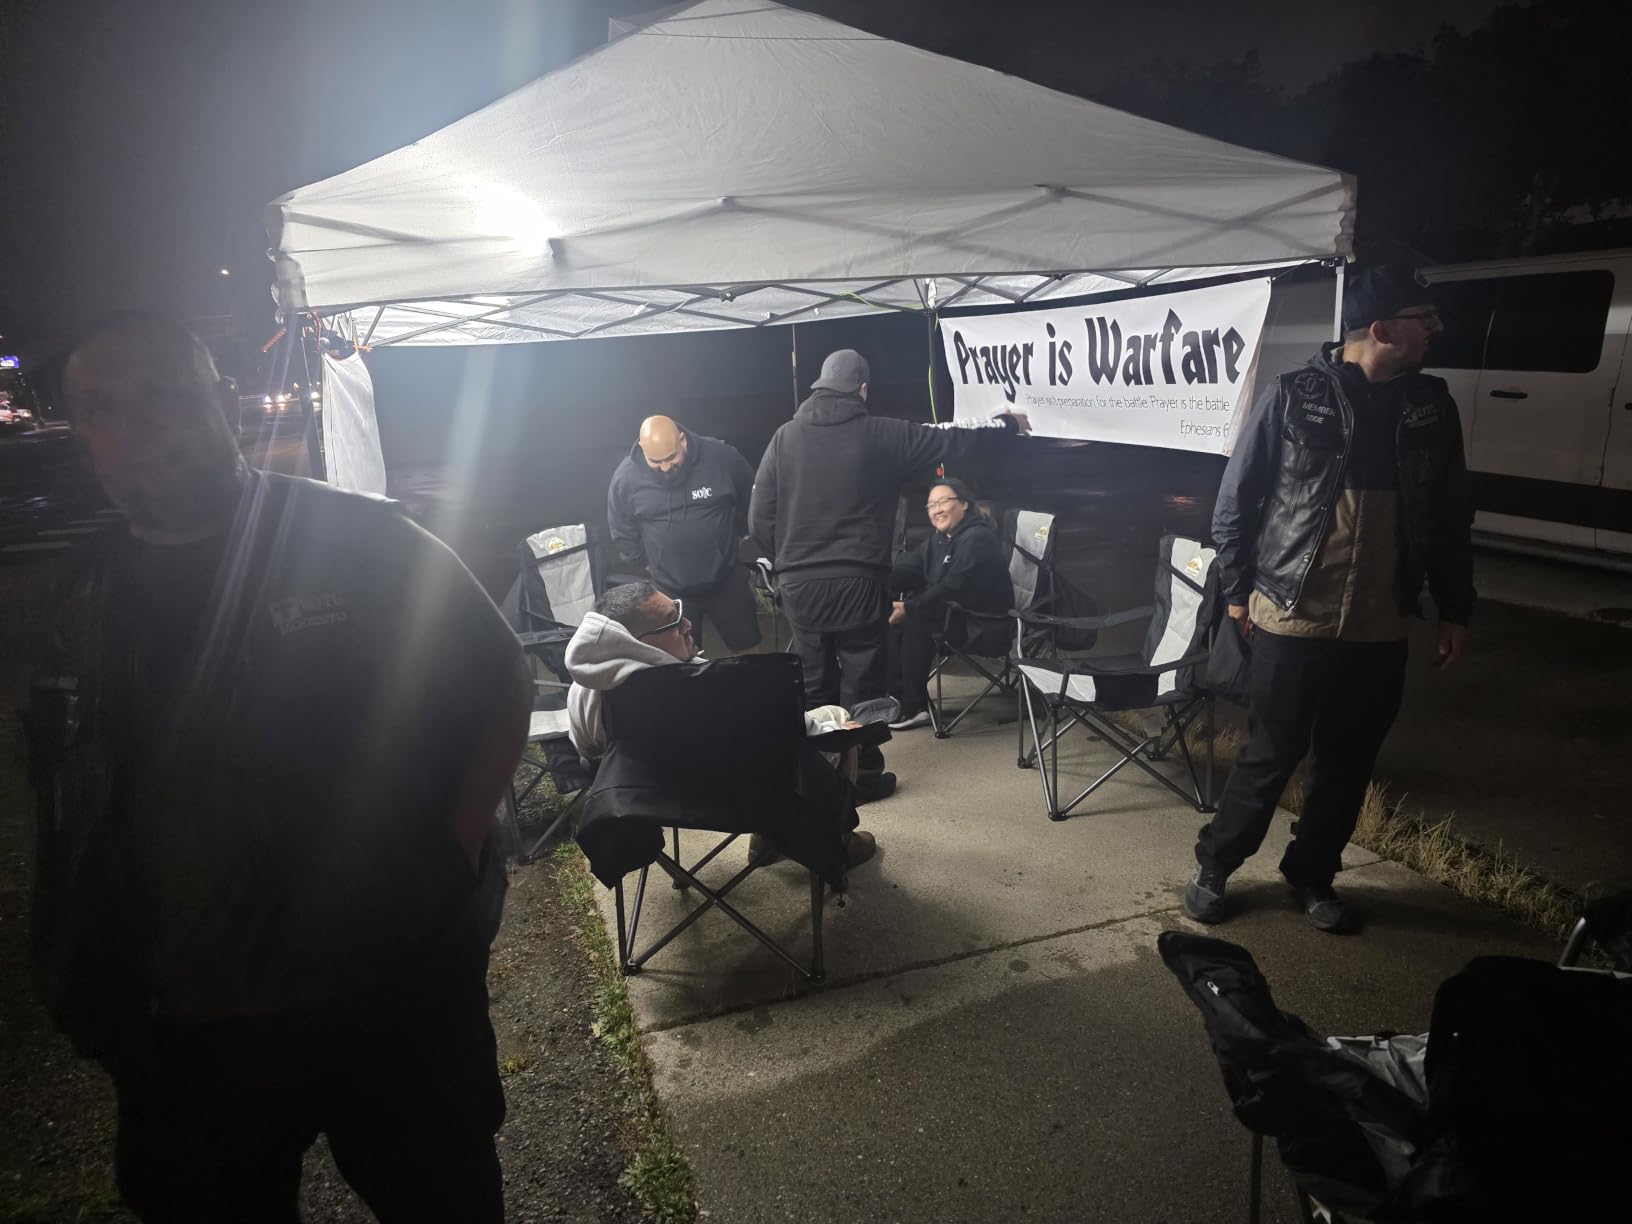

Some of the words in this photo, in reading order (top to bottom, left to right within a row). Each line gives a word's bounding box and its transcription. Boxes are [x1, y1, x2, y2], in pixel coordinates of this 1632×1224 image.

[953, 329, 1034, 403] Prayer
[1046, 322, 1073, 386] is
[1085, 308, 1246, 387] Warfare
[1025, 393, 1045, 407] Prayer
[1057, 395, 1093, 408] preparation
[1094, 395, 1106, 408] for
[1109, 395, 1122, 408] the
[1123, 395, 1150, 409] battle.
[1150, 395, 1178, 412] Prayer
[1181, 398, 1187, 409] is
[1189, 394, 1203, 410] the
[1205, 395, 1232, 412] battle.
[1302, 402, 1336, 416] MEMBER
[1180, 420, 1221, 438] Ephesians
